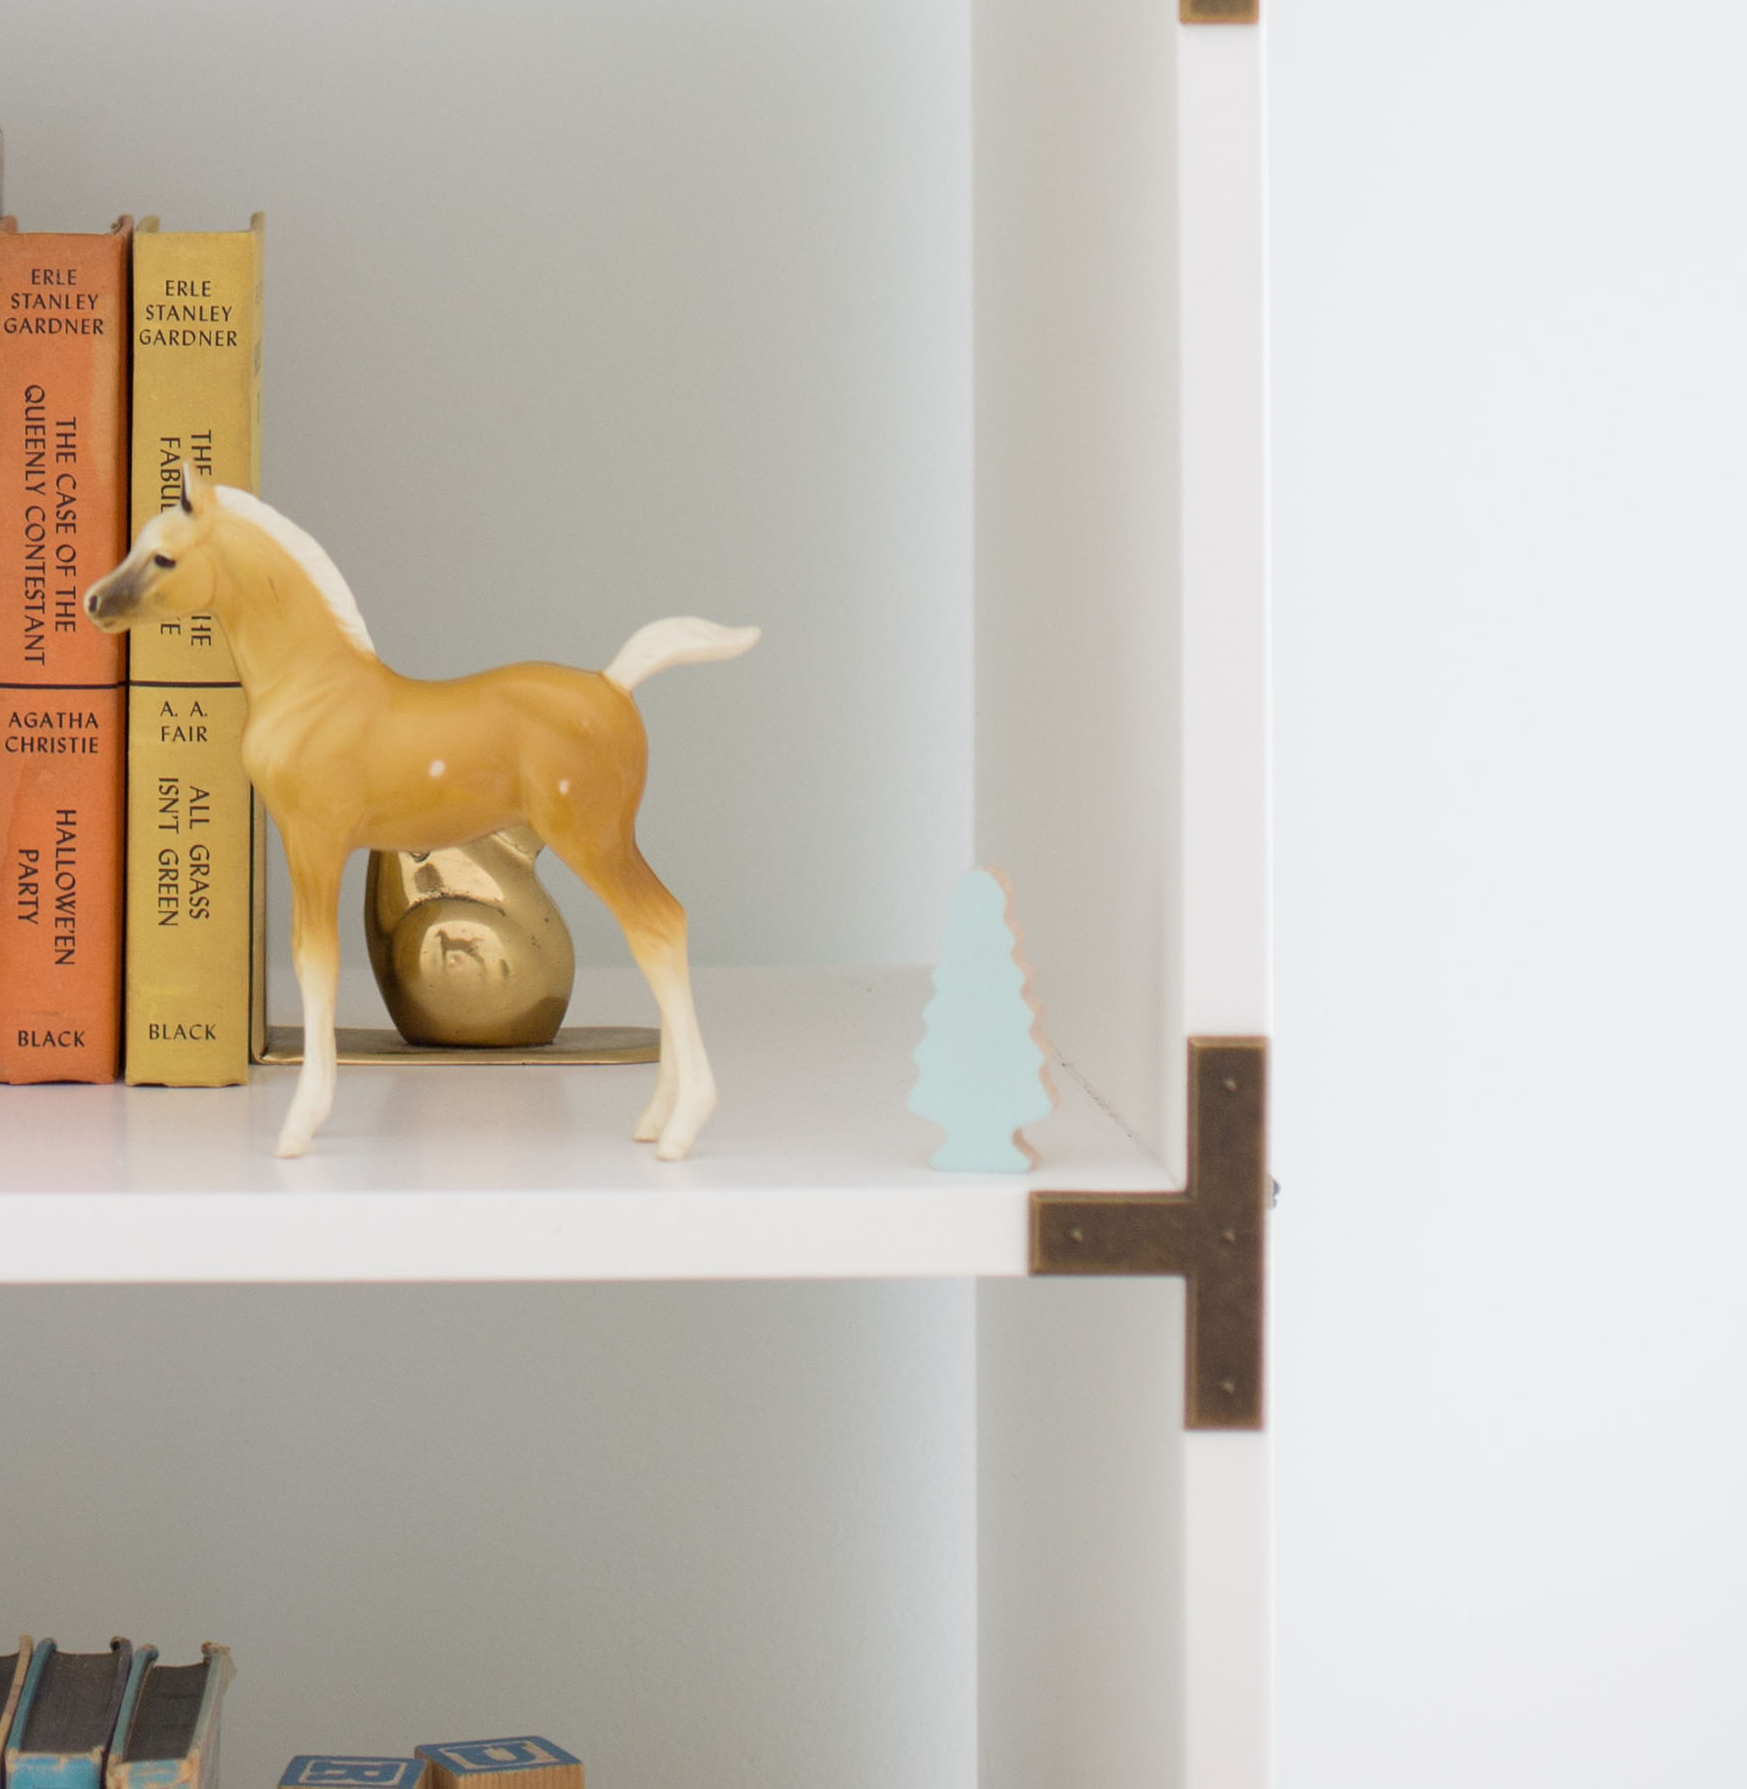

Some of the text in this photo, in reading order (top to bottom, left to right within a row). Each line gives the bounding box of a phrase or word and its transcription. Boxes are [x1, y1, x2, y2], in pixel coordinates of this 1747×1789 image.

[31, 269, 77, 285] ERLE
[164, 280, 211, 297] ERLE
[10, 293, 99, 310] STANLEY
[145, 304, 232, 322] STANLEY
[3, 318, 104, 335] GARDNER
[139, 329, 237, 347] GARDNER
[160, 436, 181, 513] FABUL
[24, 384, 46, 665] QUEENLY CONTESTANT
[55, 416, 76, 633] THE CASE OF THE
[190, 614, 212, 646] HE
[160, 701, 208, 718] A. A.
[9, 711, 98, 730] AGATHA
[161, 725, 208, 743] FAIR
[5, 736, 99, 755] CHRISTIE
[158, 777, 179, 927] ISN'T GREEN
[189, 785, 210, 920] ALL GRASS
[17, 848, 39, 925] PARTY
[54, 809, 76, 965] HALLOWE'EN
[17, 1030, 85, 1048] BLACK
[148, 1024, 217, 1041] BLACK
